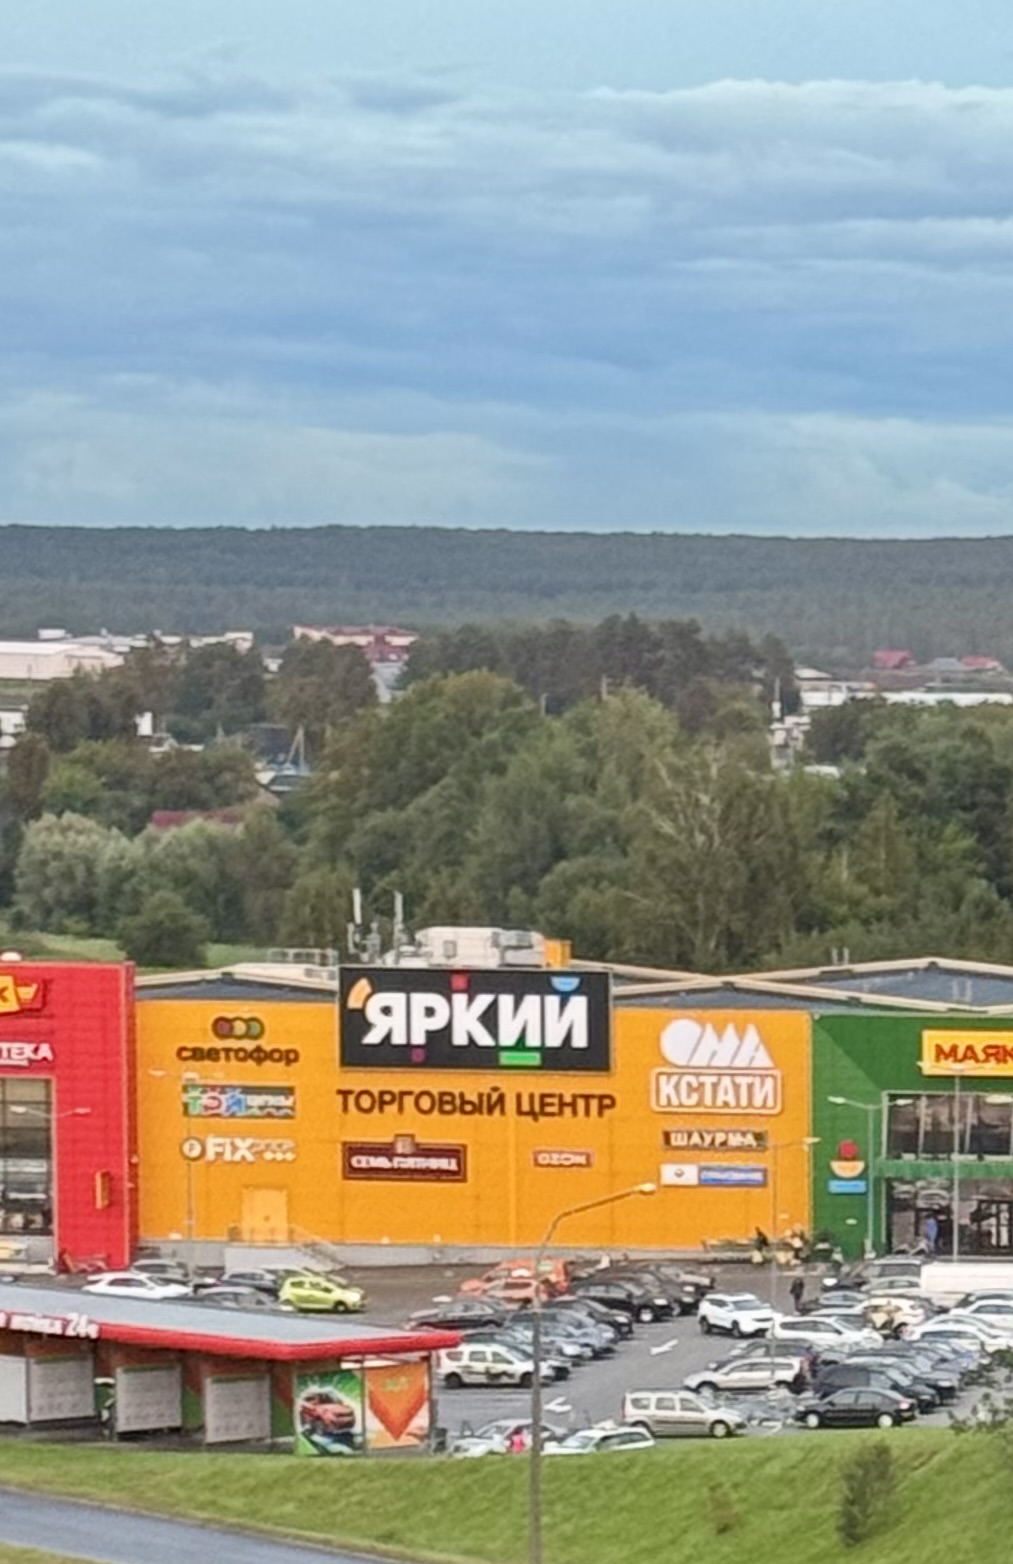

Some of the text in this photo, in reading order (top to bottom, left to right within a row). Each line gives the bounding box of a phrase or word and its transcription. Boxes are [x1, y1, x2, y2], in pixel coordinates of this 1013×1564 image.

[361, 977, 588, 1048] ЯРКИЙ
[176, 1046, 299, 1066] светофор
[336, 1087, 616, 1122] ТОРГОВЫЙ ЦЕНТР
[658, 1075, 774, 1108] КСТАТИ
[205, 1137, 255, 1161] FIX
[670, 1132, 757, 1147] ШАУРМА
